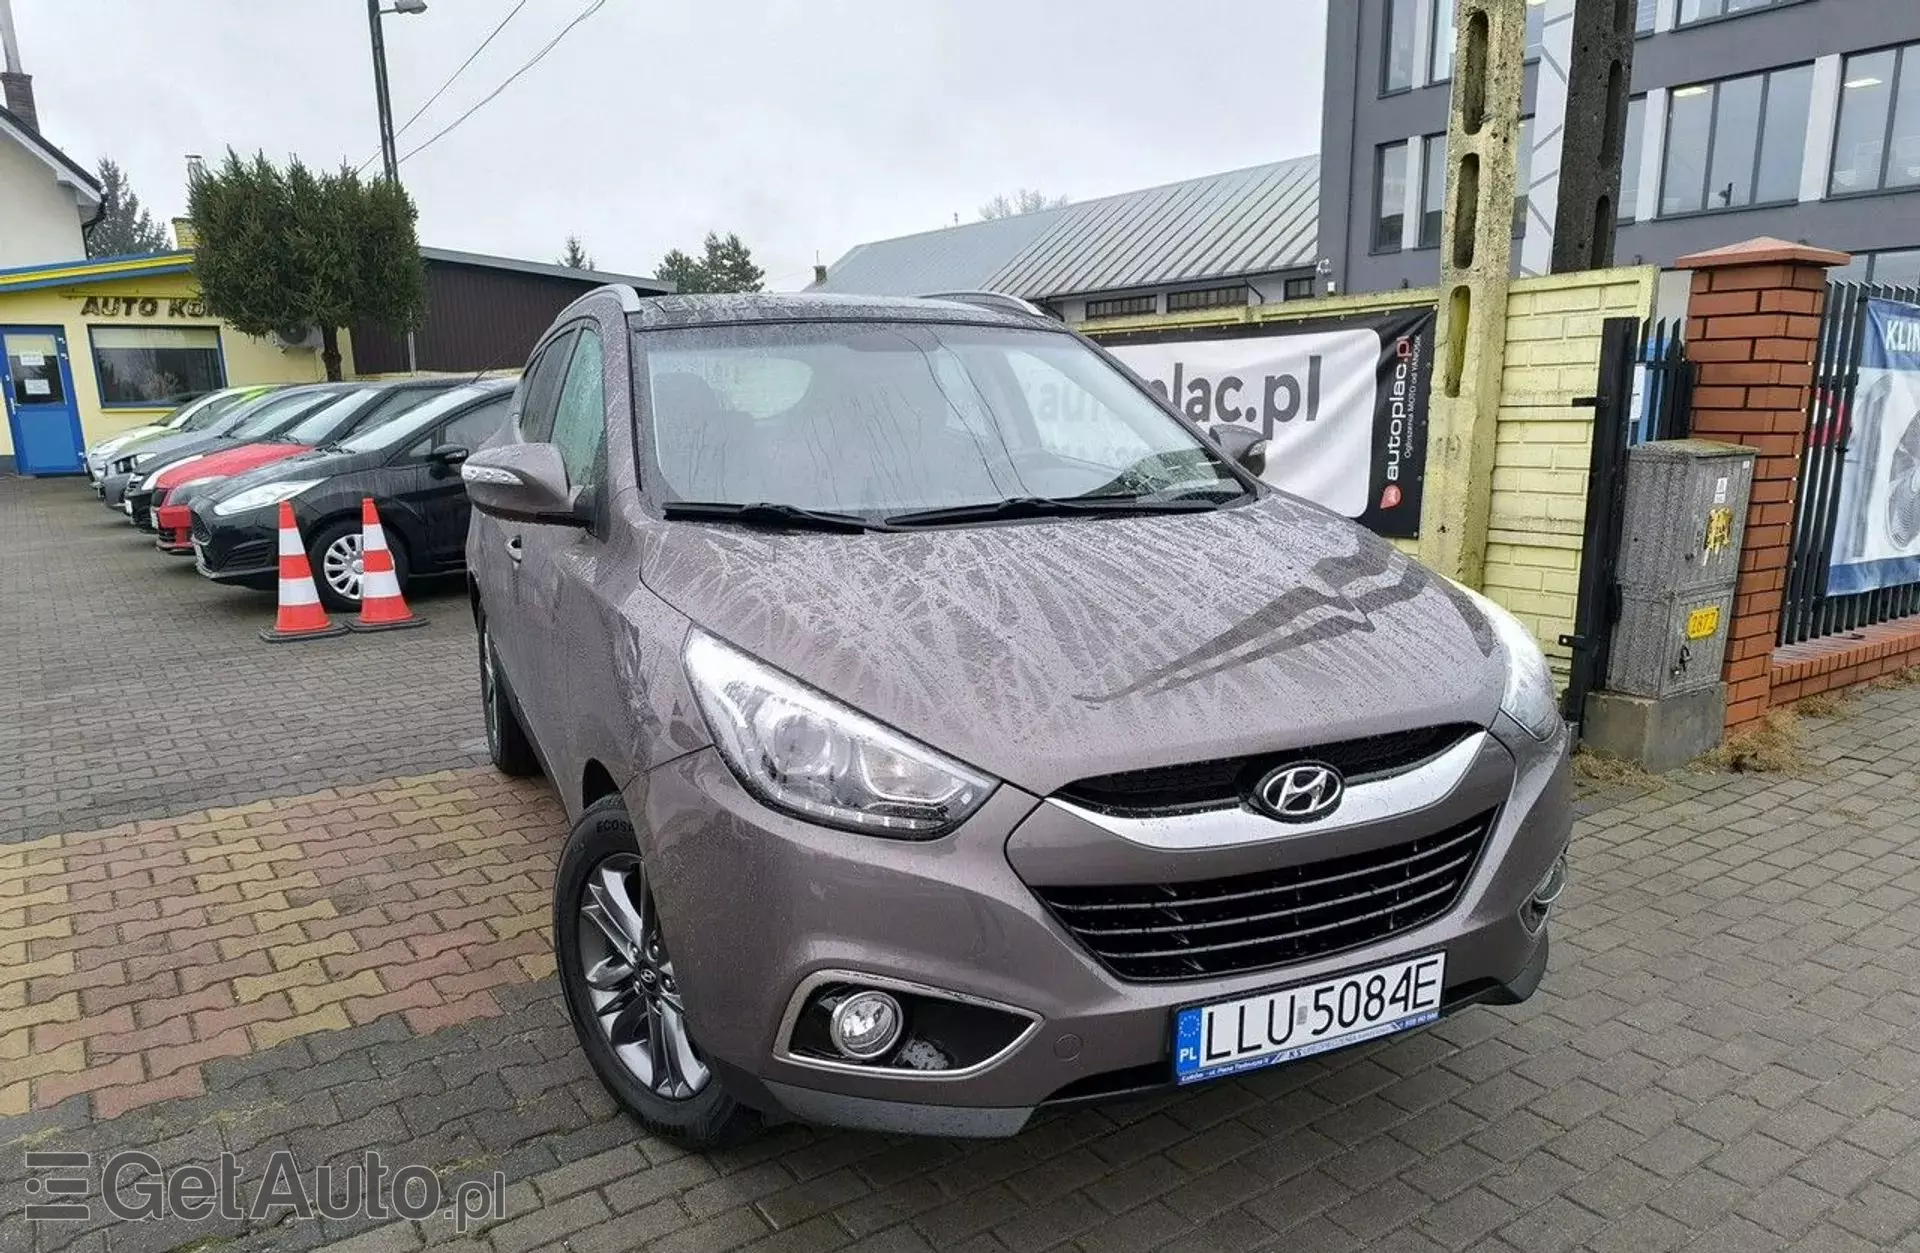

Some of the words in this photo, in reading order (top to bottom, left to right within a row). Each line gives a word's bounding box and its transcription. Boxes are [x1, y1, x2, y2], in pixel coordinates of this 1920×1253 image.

[81, 297, 158, 317] AUTO
[1387, 335, 1412, 481] autoplac.pl
[1407, 385, 1417, 412] MOTO
[1205, 995, 1296, 1061] LLU
[1311, 959, 1439, 1036] 5084E
[1180, 1047, 1198, 1063] PL
